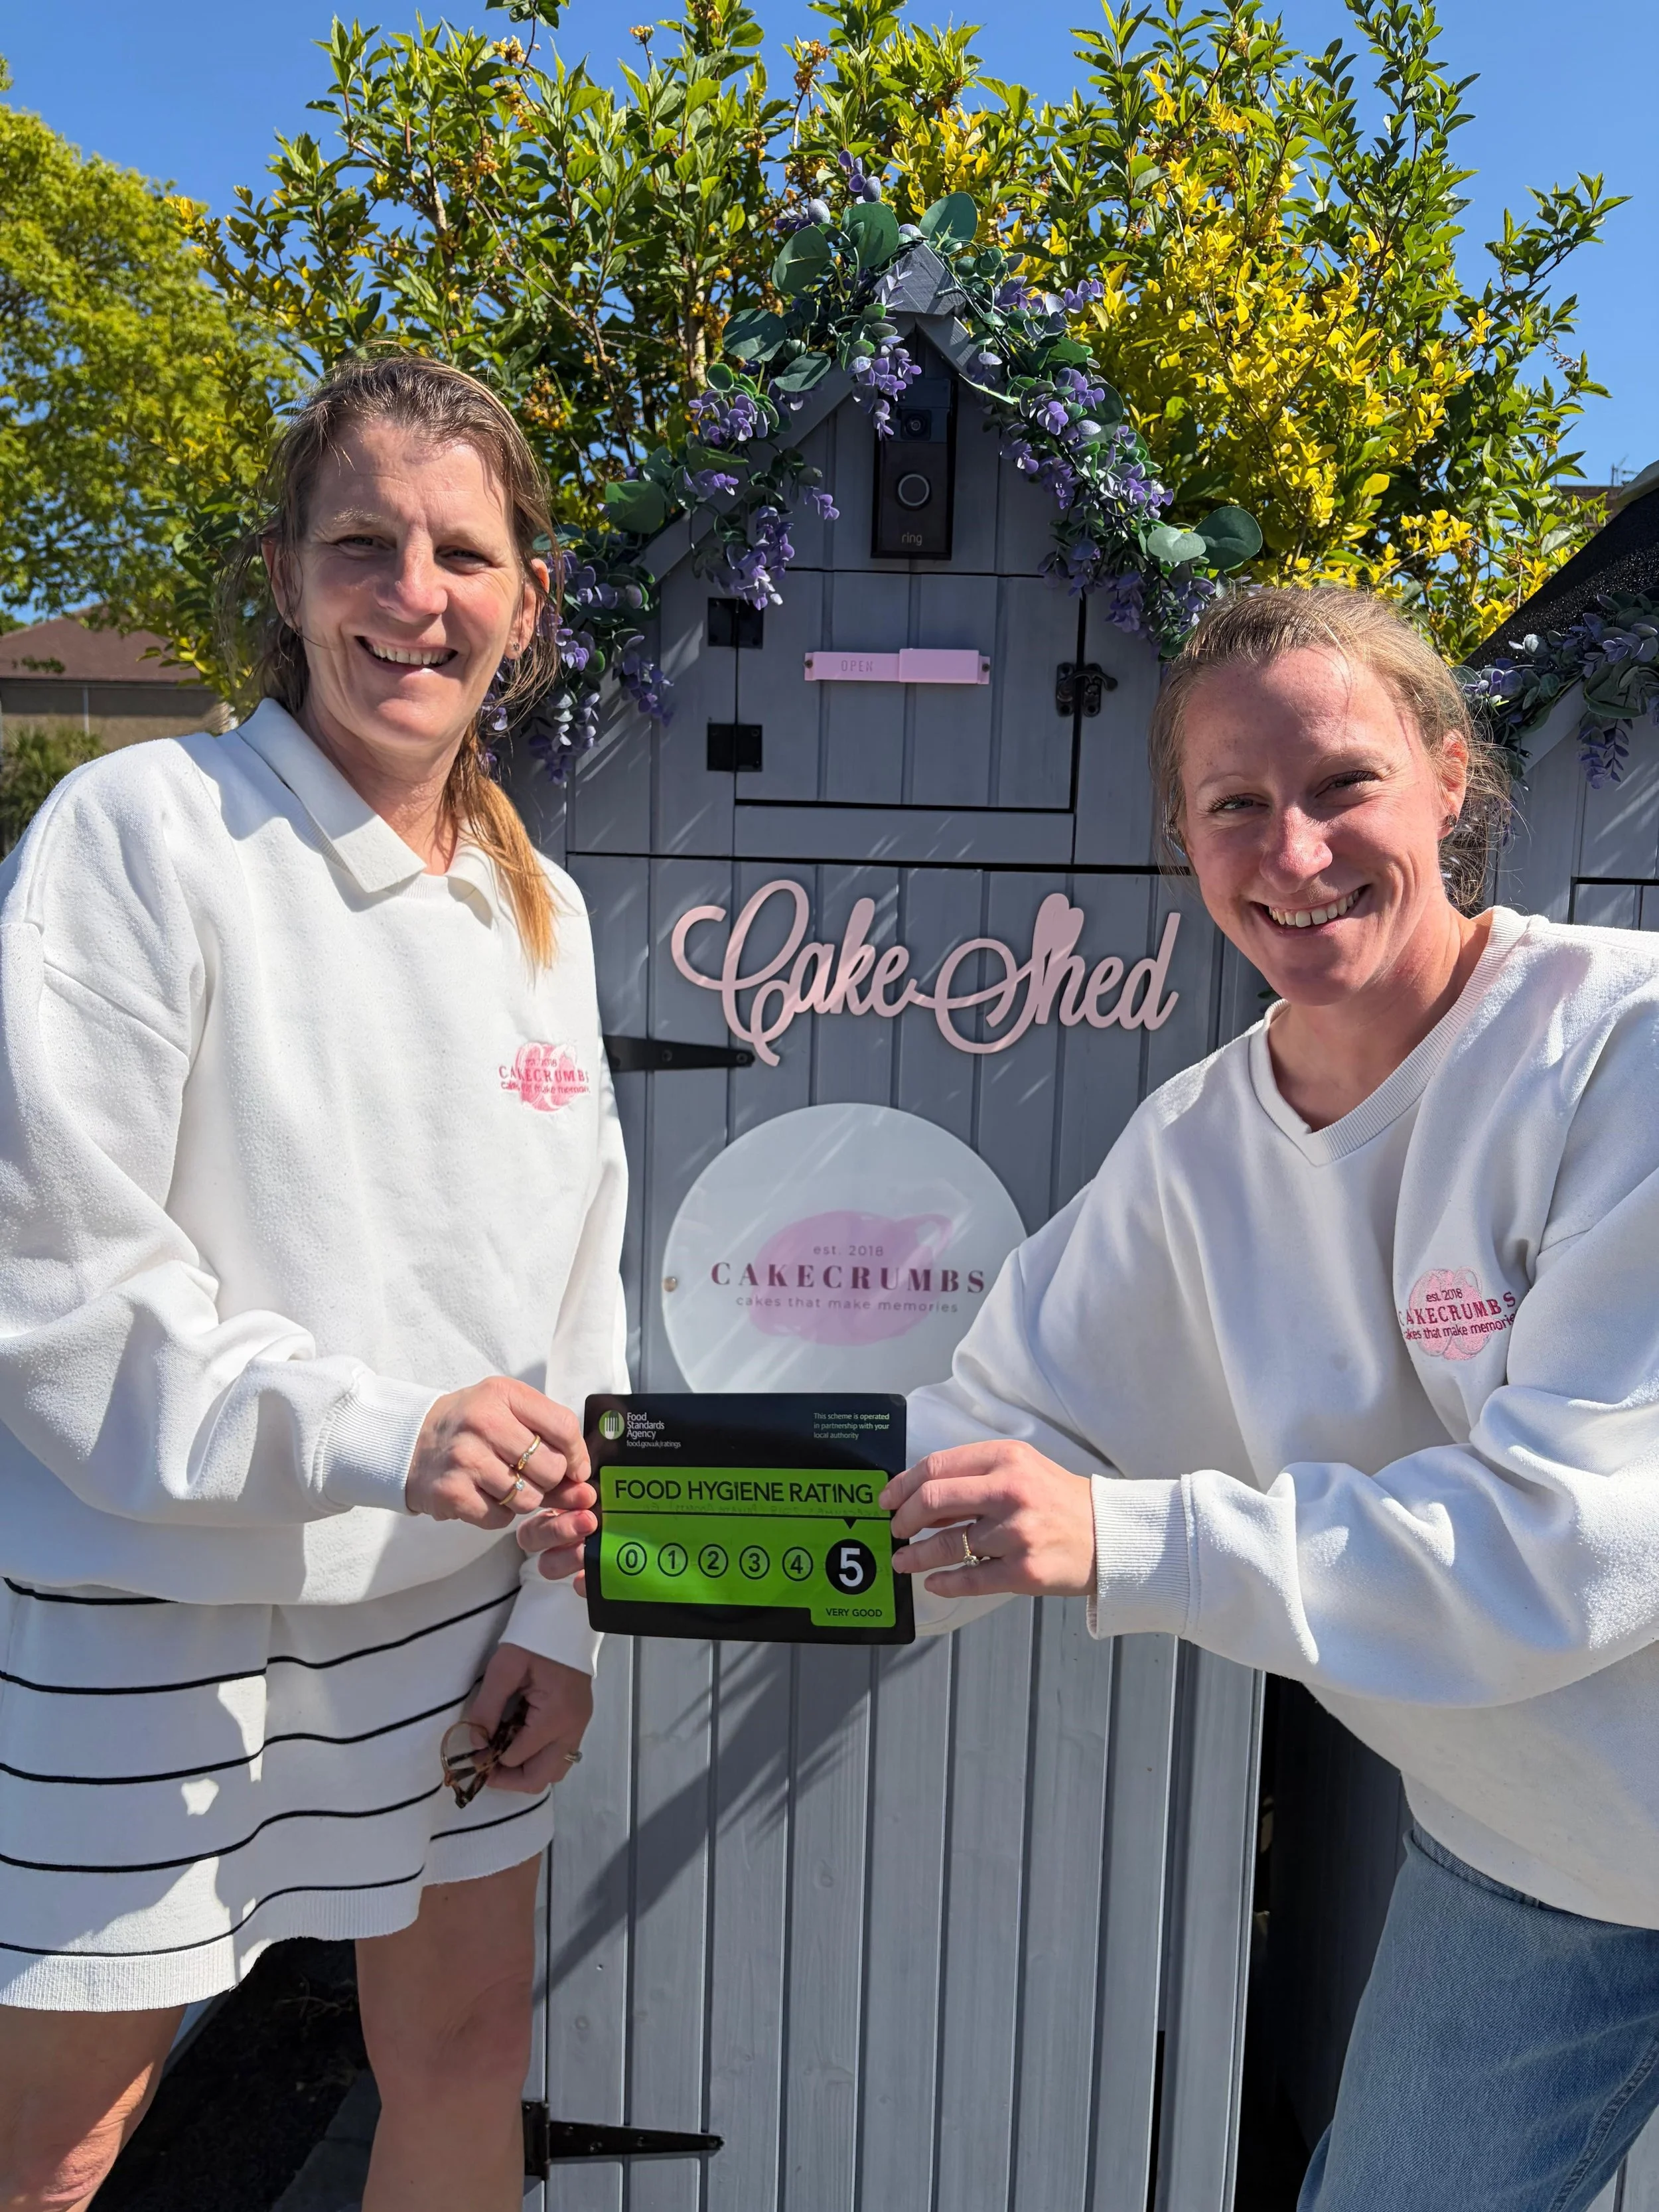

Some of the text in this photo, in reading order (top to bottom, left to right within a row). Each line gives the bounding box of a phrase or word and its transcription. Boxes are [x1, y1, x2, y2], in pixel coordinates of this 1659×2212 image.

[901, 532, 922, 547] ring
[840, 659, 874, 672] OPEN
[671, 879, 1181, 1067] Cake Shed
[813, 1245, 884, 1257] est. 2018
[711, 1262, 985, 1294] CAKECRUMBS
[1441, 1288, 1463, 1300] 2018
[735, 1295, 958, 1313] cakes that make memories
[1404, 1313, 1516, 1340] akes that make memorie
[626, 1412, 647, 1421] Food
[626, 1420, 665, 1430] Standards
[821, 1422, 859, 1431] partnership
[626, 1429, 656, 1440] Agency
[830, 1432, 859, 1441] authority
[614, 1479, 873, 1505] FOOD HYGIENE RATING
[625, 1547, 864, 1587] 0 1 2 3 4 5
[825, 1607, 883, 1617] VERY GOOD
